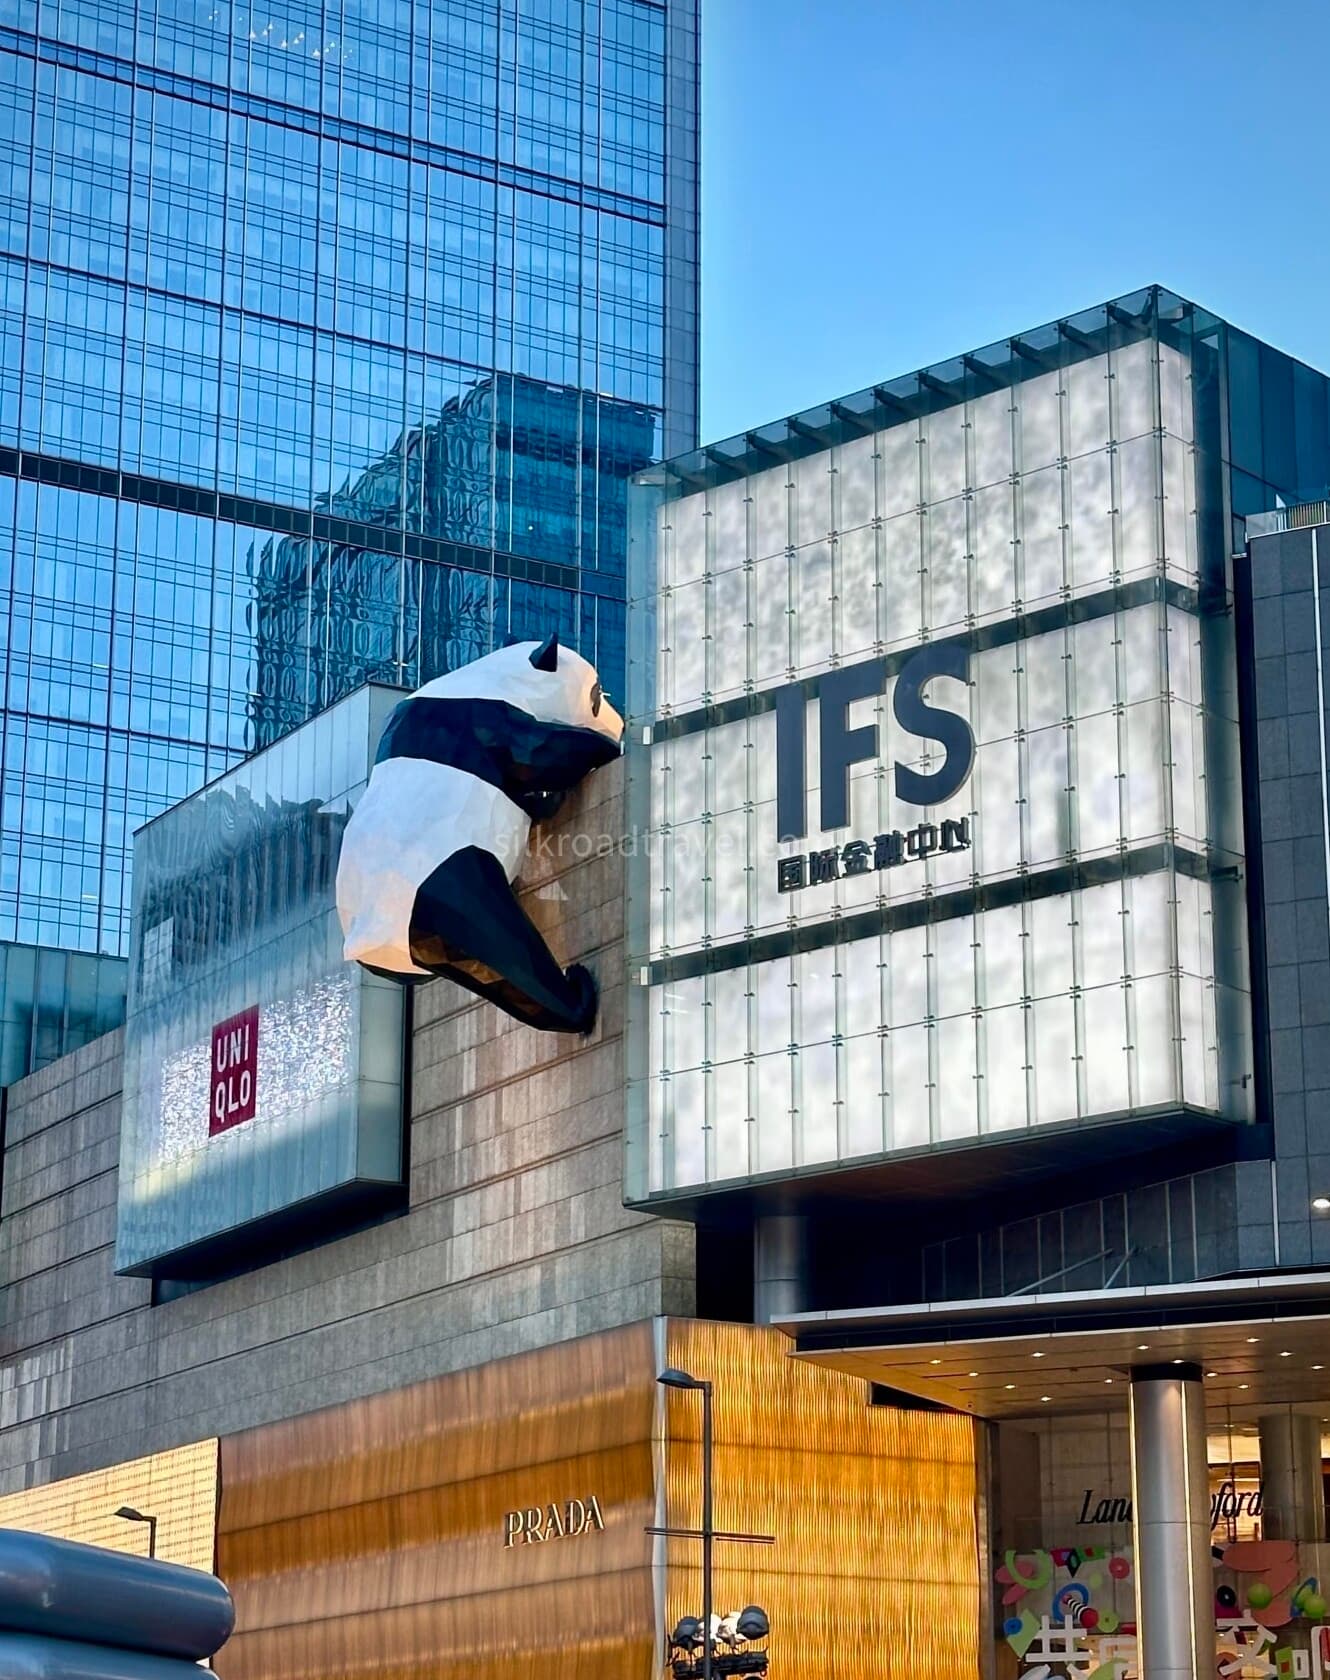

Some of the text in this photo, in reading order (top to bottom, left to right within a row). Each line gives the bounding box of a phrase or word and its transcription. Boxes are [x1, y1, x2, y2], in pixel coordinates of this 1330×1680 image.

[776, 644, 977, 843] IFS
[777, 816, 972, 894] 国际金融中心
[216, 1023, 249, 1072] UNI
[215, 1070, 251, 1123] QLO
[504, 1495, 605, 1549] PRADA
